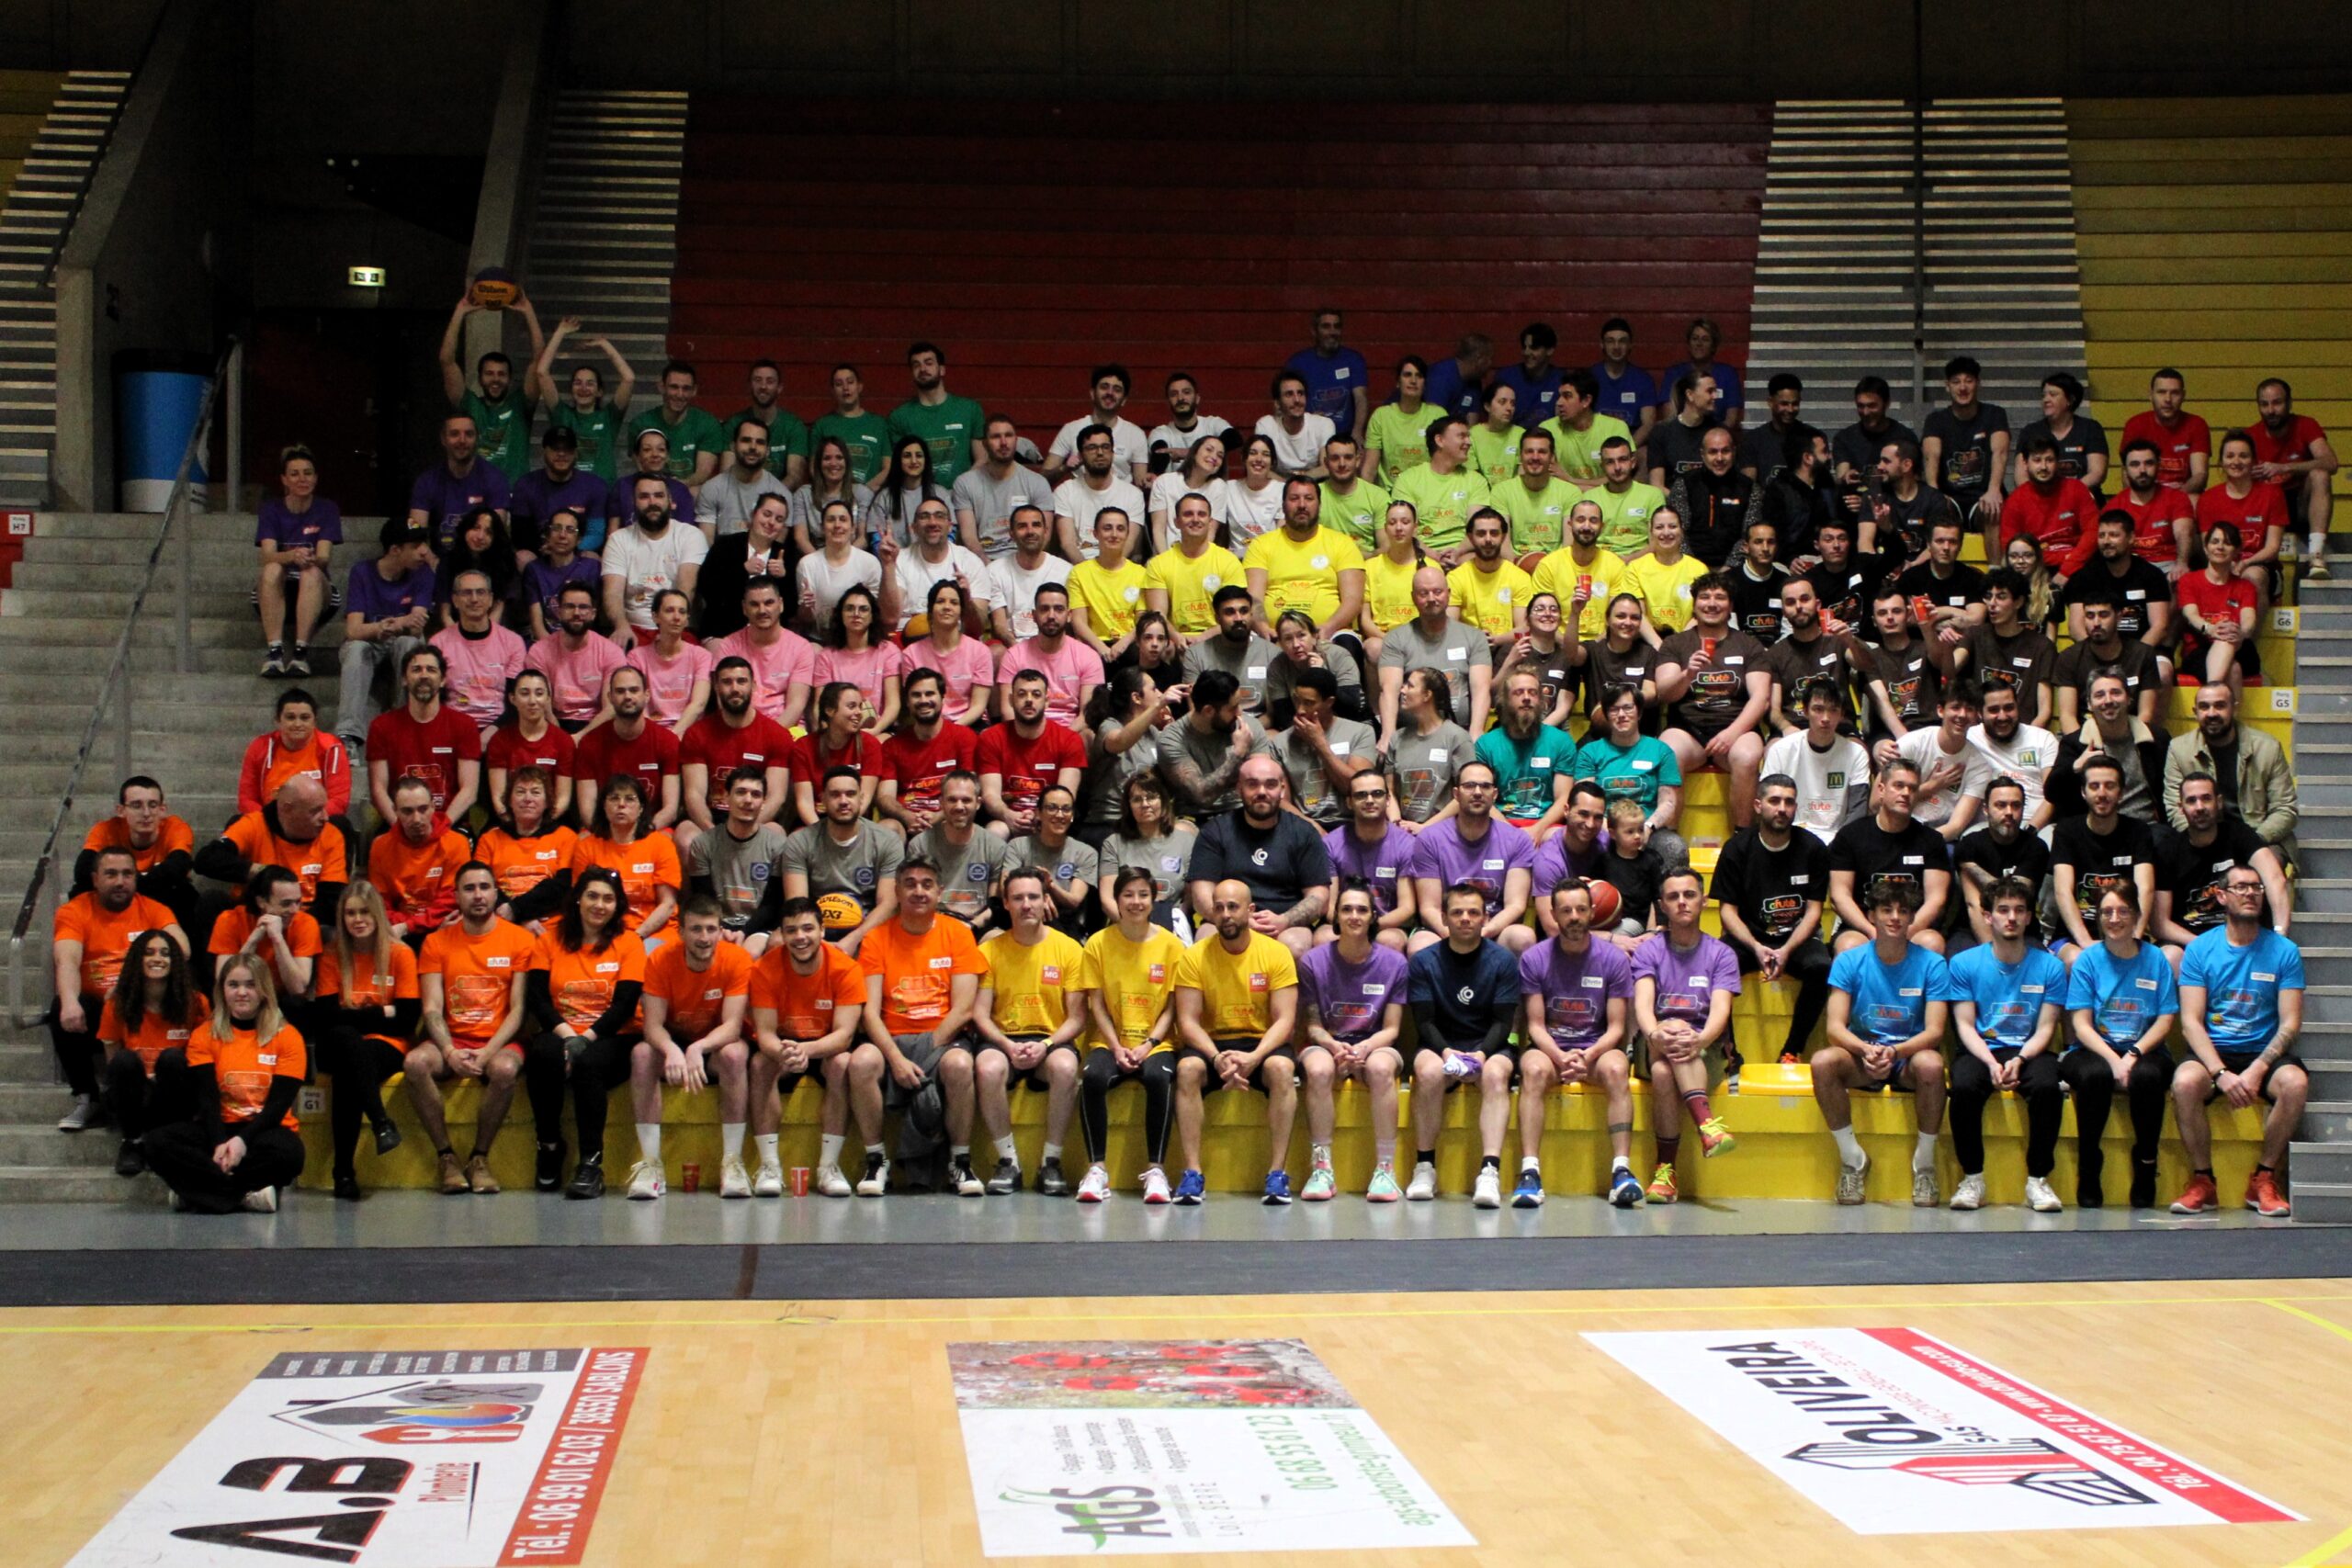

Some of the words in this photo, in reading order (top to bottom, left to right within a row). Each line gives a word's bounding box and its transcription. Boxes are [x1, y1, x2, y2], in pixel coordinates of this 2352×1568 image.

[2278, 617, 2291, 626] G6
[2276, 699, 2290, 707] G5
[1044, 971, 1058, 980] MG
[1152, 969, 1165, 977] MG
[1250, 978, 1266, 987] MG
[304, 1102, 319, 1111] G1
[582, 1352, 635, 1393] SABLONS
[1707, 1342, 1942, 1445] OLIVEIRA
[569, 1394, 619, 1425] 38550
[1245, 1416, 1294, 1427] 23
[559, 1435, 605, 1449] 03
[1255, 1430, 1304, 1440] 61
[1944, 1427, 1999, 1443] SAS
[1264, 1444, 1316, 1456] 55
[552, 1451, 599, 1465] 62
[1274, 1460, 1327, 1472] 68
[545, 1468, 594, 1481] 01
[417, 1462, 471, 1502] Plomberie
[1284, 1476, 1339, 1490] 06
[537, 1484, 587, 1500] 99
[1190, 1482, 1230, 1510] SERRE
[528, 1503, 581, 1521] 06
[1049, 1485, 1171, 1537] AGS
[513, 1531, 571, 1558] Tél.
